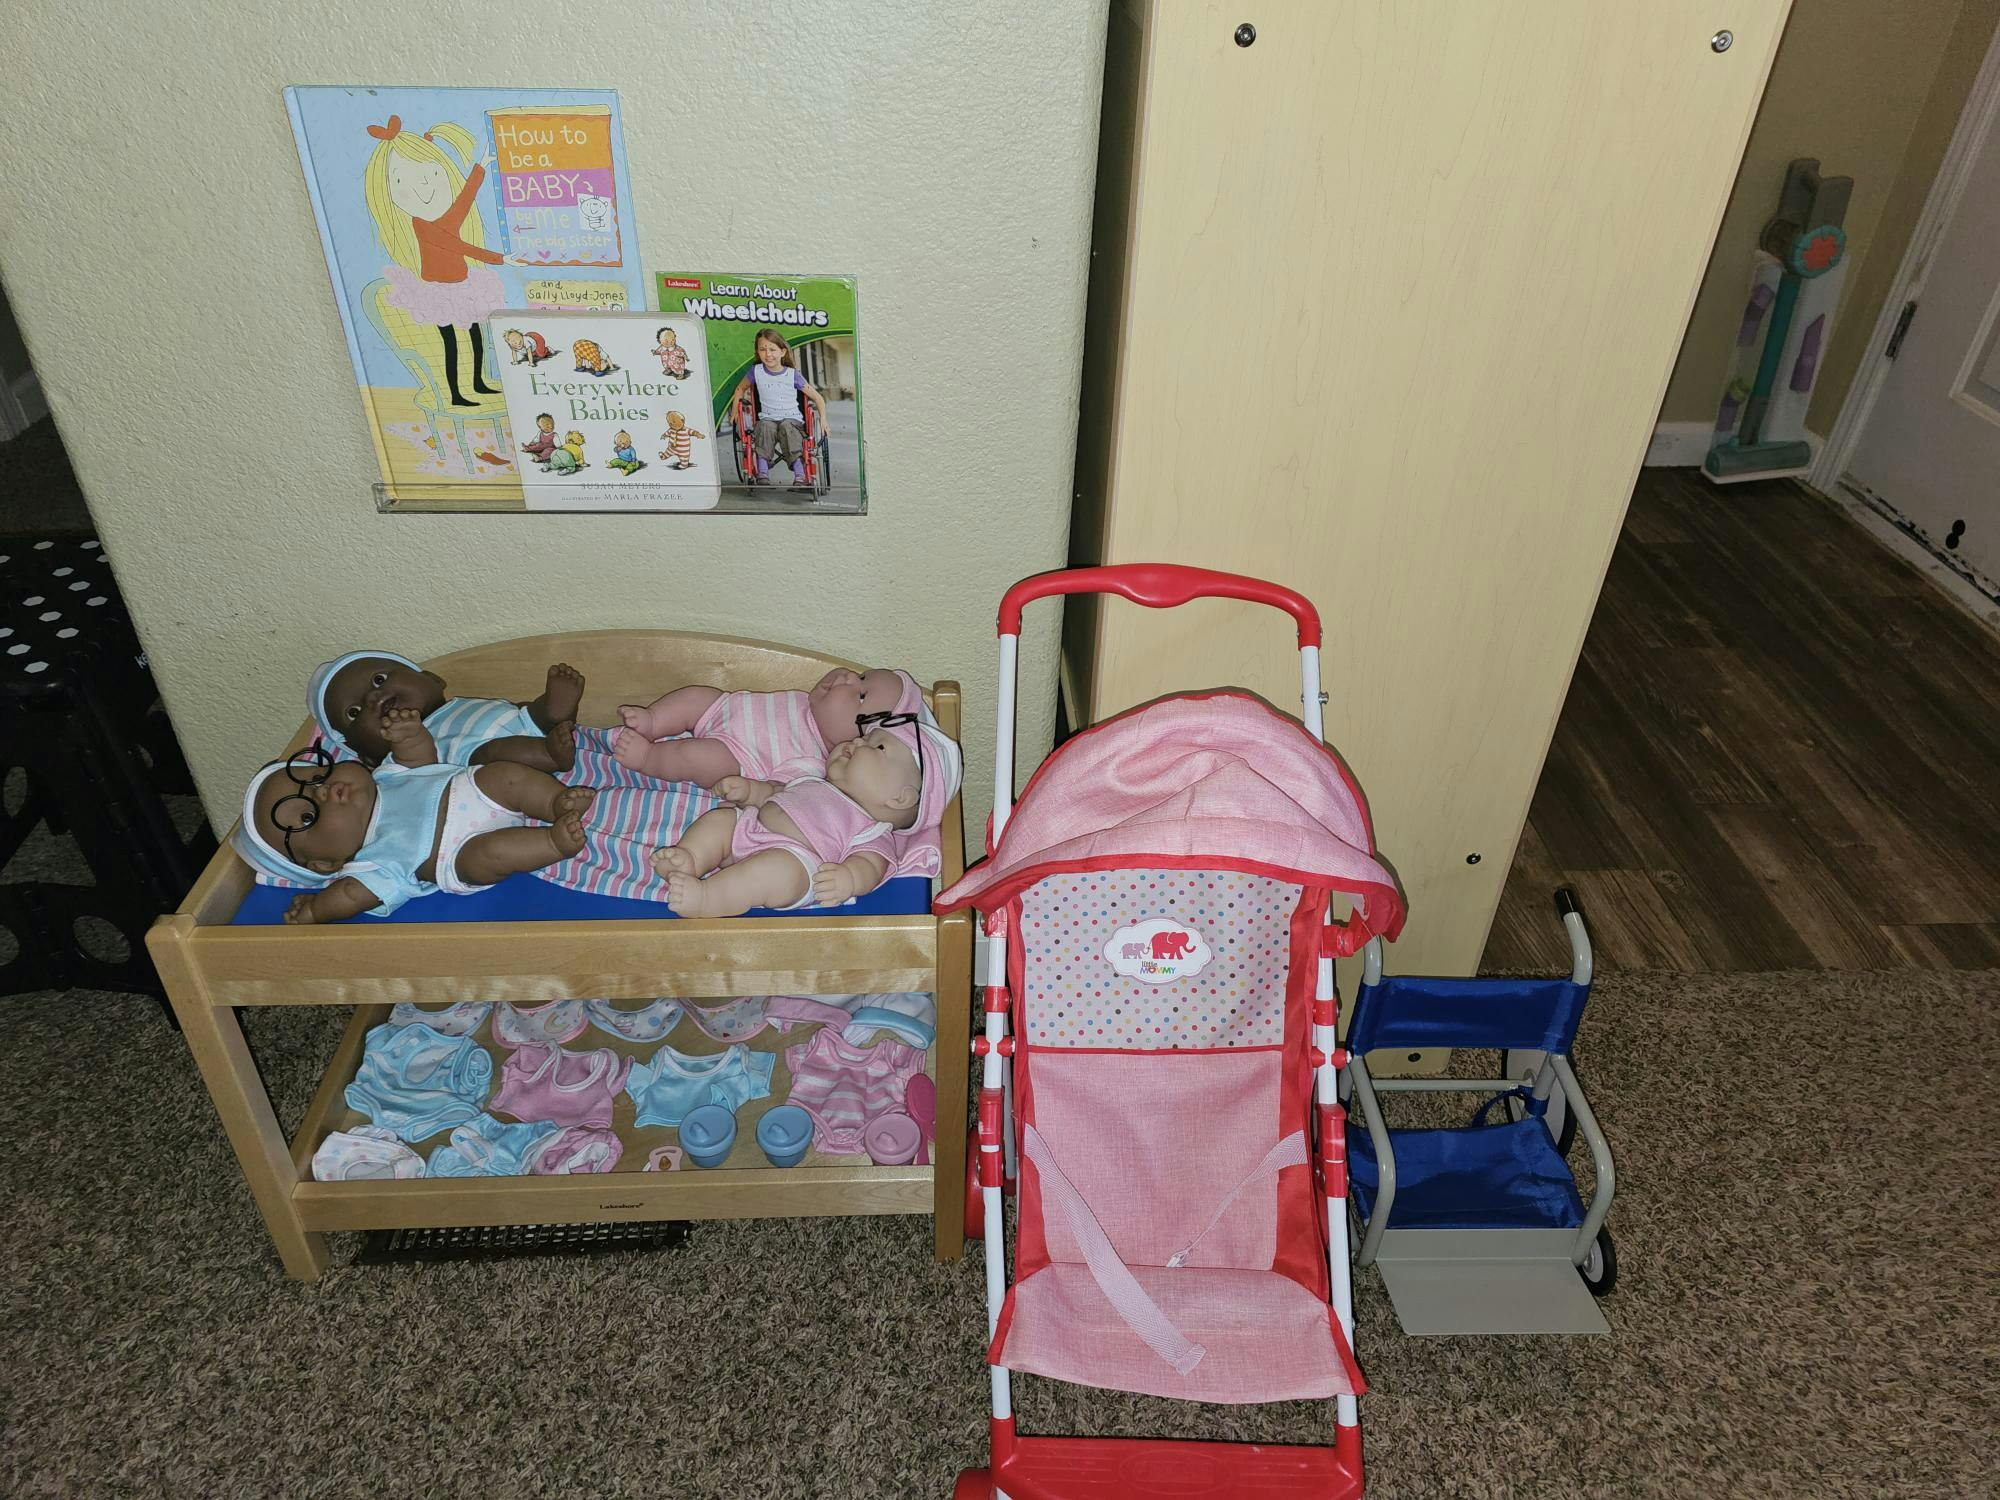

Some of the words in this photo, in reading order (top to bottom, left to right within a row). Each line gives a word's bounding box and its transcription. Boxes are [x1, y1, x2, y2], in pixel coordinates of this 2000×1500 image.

[498, 124, 554, 148] How
[560, 125, 587, 145] to
[509, 151, 533, 169] be
[538, 154, 553, 168] a
[507, 173, 580, 203] BABY
[528, 289, 558, 303] Sally
[560, 290, 624, 303] Lloyd-Jones
[541, 281, 563, 290] and
[709, 281, 750, 297] Learn
[753, 284, 797, 300] About
[683, 297, 828, 326] Wheelchairs
[528, 370, 679, 400] Everywhere
[569, 396, 649, 421] Babies
[582, 482, 614, 490] SUSAN
[618, 482, 661, 490] MEYERS
